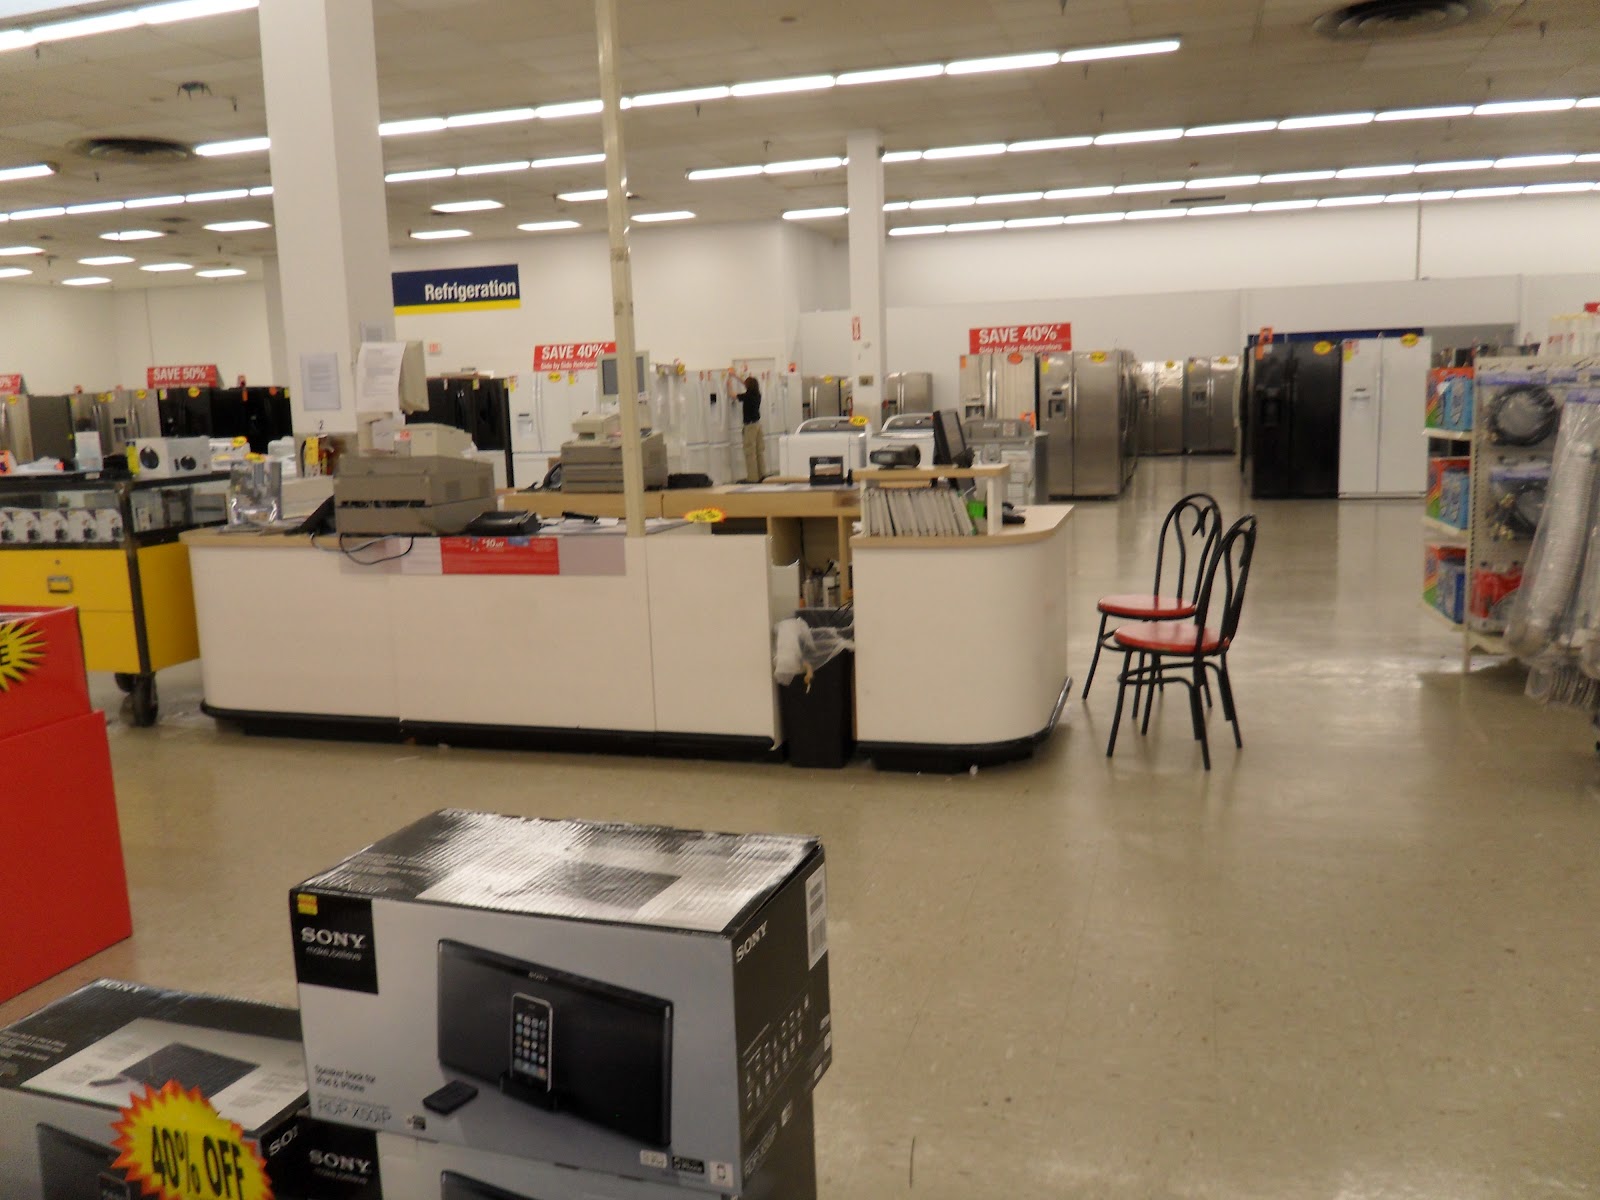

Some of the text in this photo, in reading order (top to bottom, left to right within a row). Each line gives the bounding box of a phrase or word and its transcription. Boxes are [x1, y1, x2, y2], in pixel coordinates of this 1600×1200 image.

[424, 279, 517, 303] Refrigeration
[979, 327, 1019, 345] SAVE
[541, 345, 574, 361] SAVE
[154, 367, 180, 381] SAVE
[301, 926, 367, 949] SONY
[736, 920, 768, 963] SONY
[269, 1125, 299, 1157] SO
[151, 1125, 243, 1200] 40% OFF
[309, 1148, 371, 1174] SONY
